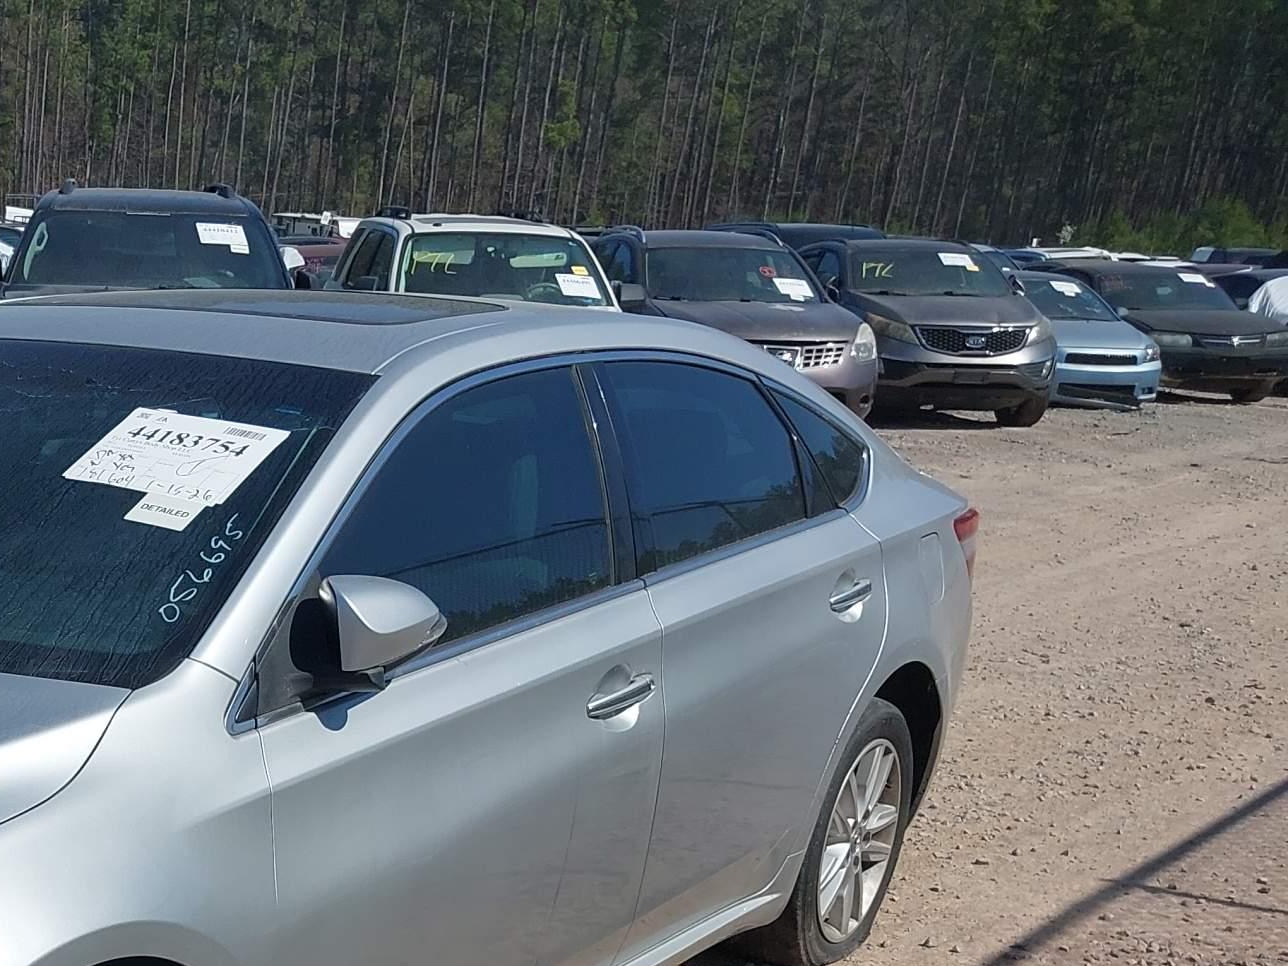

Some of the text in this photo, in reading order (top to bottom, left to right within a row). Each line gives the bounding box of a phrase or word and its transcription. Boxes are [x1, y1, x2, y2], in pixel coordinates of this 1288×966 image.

[127, 425, 251, 457] 44183754
[140, 503, 190, 519] DETAILED
[158, 512, 244, 623] 056695
